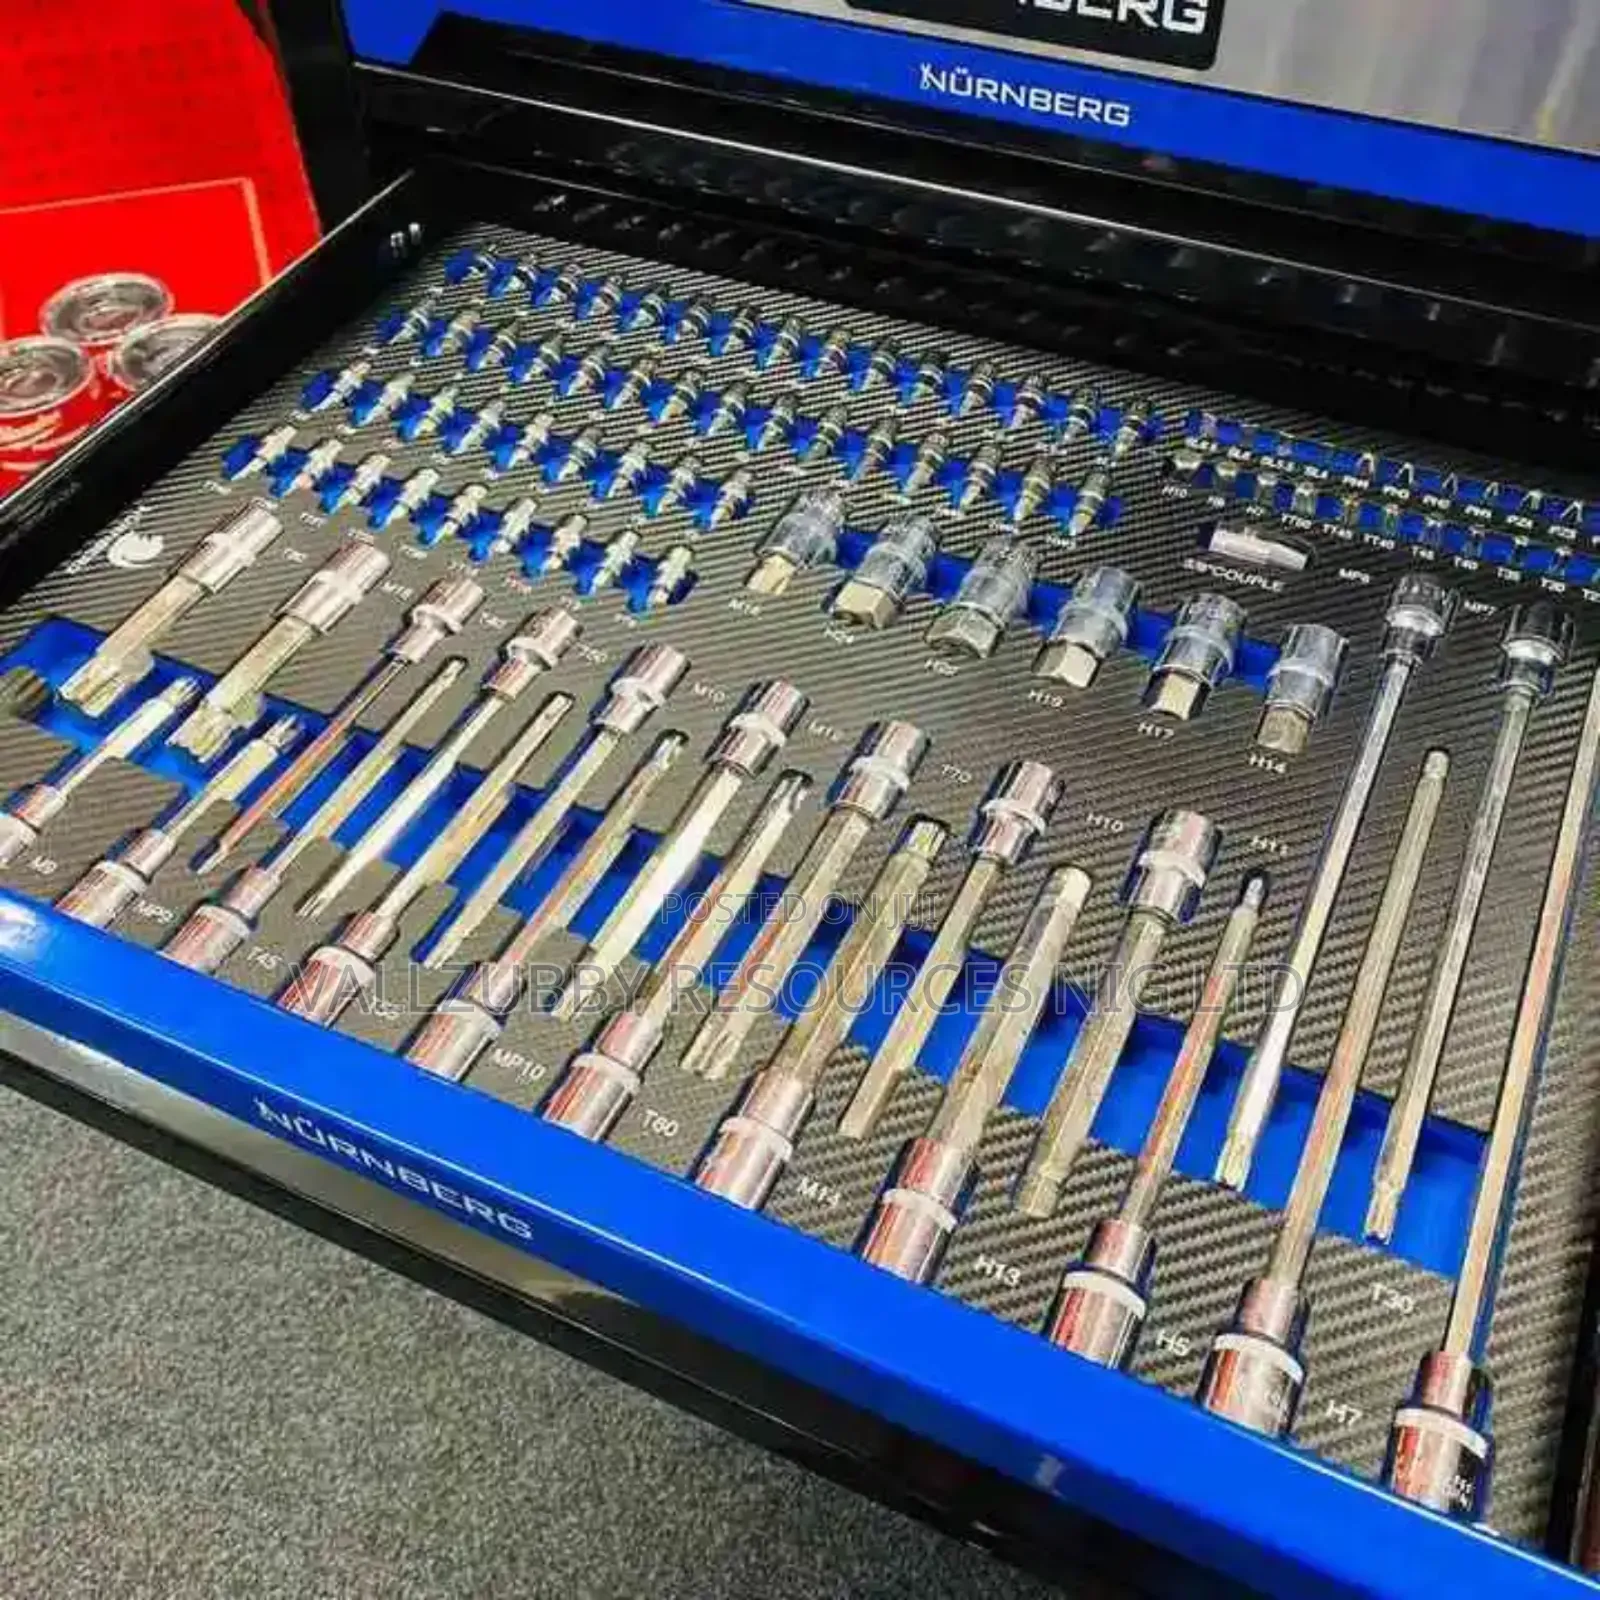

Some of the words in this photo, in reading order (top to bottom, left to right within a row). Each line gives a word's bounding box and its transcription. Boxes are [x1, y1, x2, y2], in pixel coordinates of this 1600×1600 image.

[920, 63, 1130, 127] NÜRNBERG
[1086, 812, 1124, 833] H10
[494, 1048, 547, 1081] MP10
[643, 1108, 679, 1137] T60
[974, 1253, 1021, 1287] H13
[1371, 1282, 1414, 1315] T30
[1155, 1327, 1191, 1356] H5
[1325, 1398, 1363, 1424] H7
